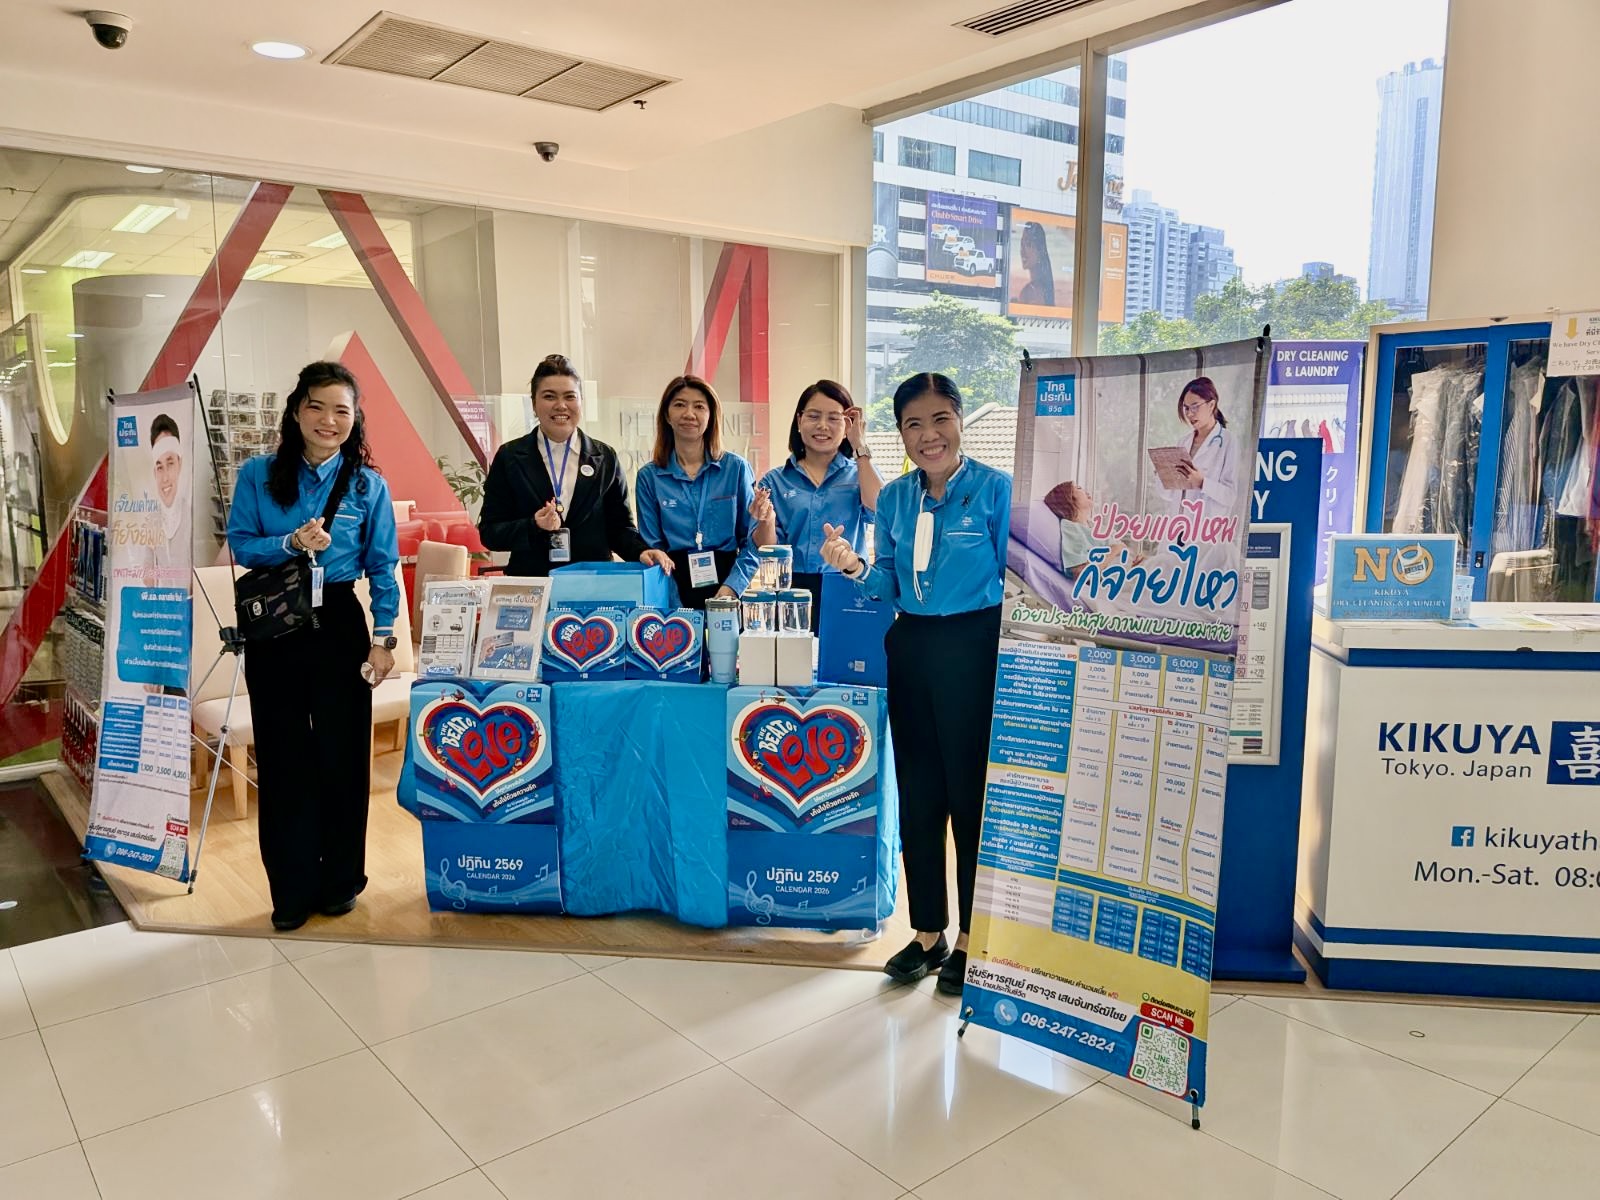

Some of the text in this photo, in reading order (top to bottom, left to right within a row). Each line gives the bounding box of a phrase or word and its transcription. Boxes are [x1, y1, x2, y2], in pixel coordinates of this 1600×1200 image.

[1277, 350, 1349, 362] DRY CLEANING
[1285, 366, 1339, 377] & LAUNDRY
[1040, 390, 1072, 402] ประกัน
[1046, 380, 1066, 392] ไทย
[1072, 545, 1239, 611] ก็จ่ายไหว
[1011, 602, 1234, 642] ด้วยประกันสุขภาพแบบเหมาจ่าย
[1088, 650, 1112, 659] 2,000
[1130, 654, 1156, 664] 3,000
[1172, 658, 1198, 669] 6,000
[442, 716, 467, 748] BEAT
[758, 720, 788, 753] BEAT
[1378, 722, 1541, 755] KIKUYA
[1556, 726, 1600, 780] 喜
[1382, 758, 1532, 781] Tokyo. Japan
[458, 854, 524, 871] ปฏิทิน 2569
[466, 872, 500, 880] CALENDAR
[766, 866, 839, 884] ปฏิทิน 2569
[1414, 861, 1540, 886] Mon.-Sat.
[776, 886, 813, 894] CALENDAR
[968, 965, 1026, 989] ผู้บริหารศูนย์
[1151, 1008, 1185, 1028] SCAN ME
[1022, 1012, 1116, 1053] 096-247-2824
